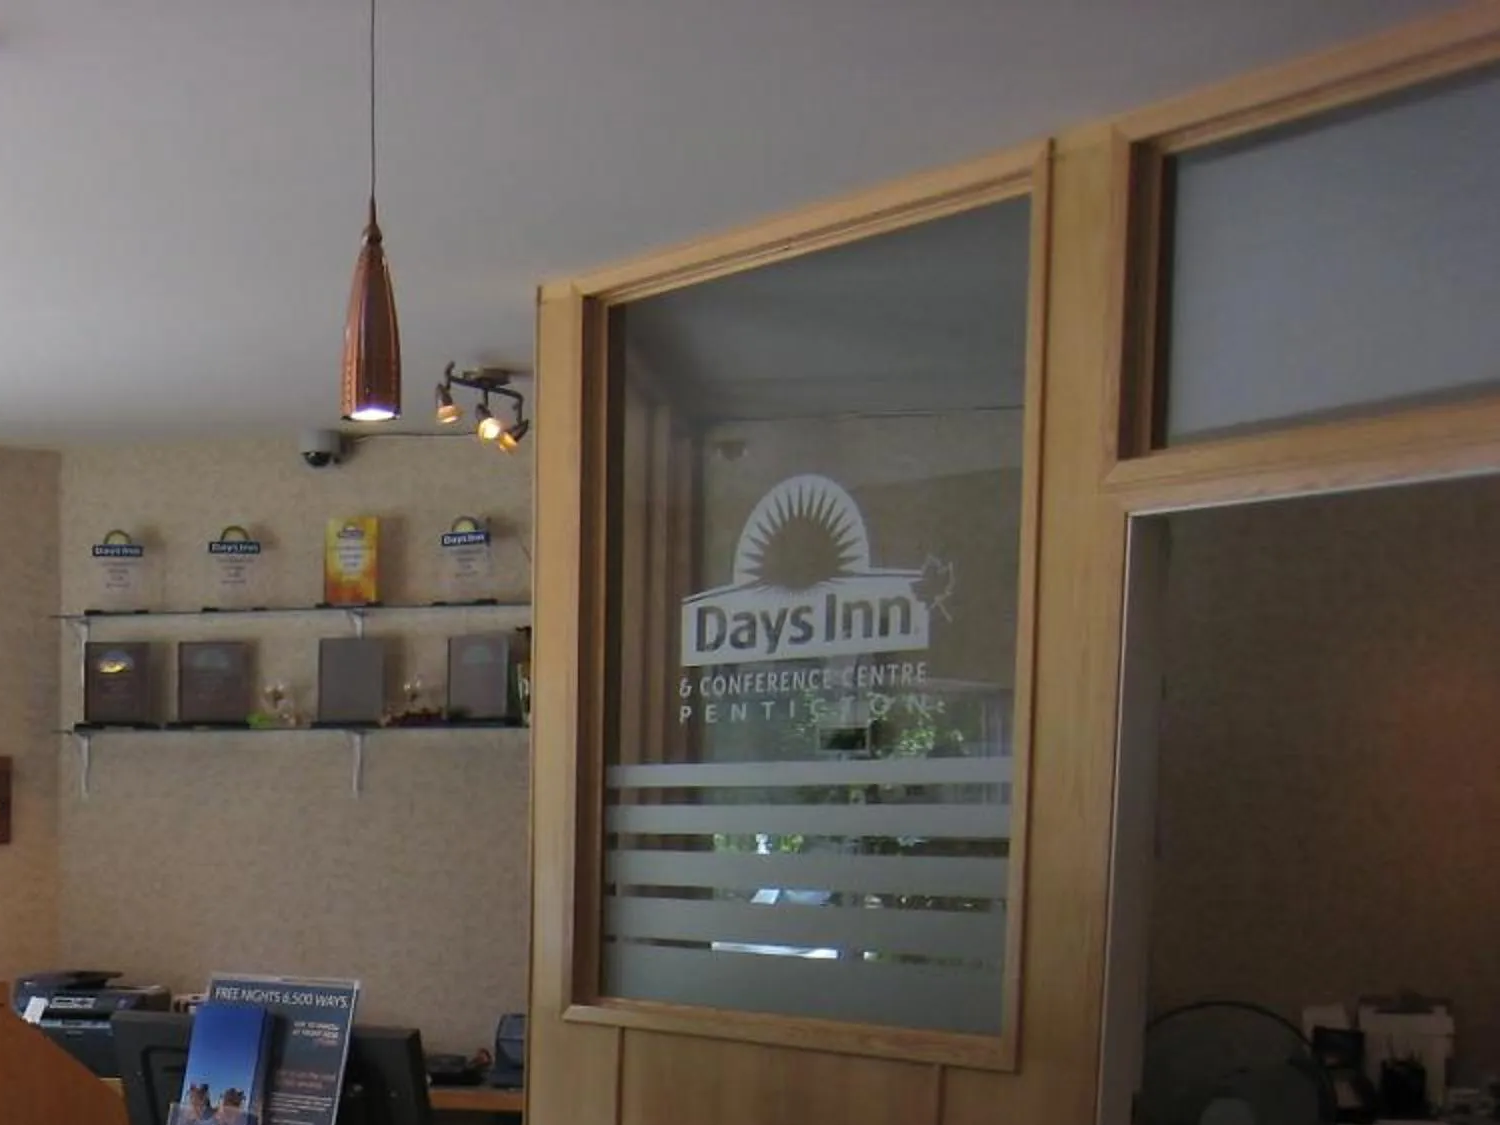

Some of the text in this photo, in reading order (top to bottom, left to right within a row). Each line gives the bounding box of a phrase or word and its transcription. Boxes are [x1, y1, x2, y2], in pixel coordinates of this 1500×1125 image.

[695, 593, 912, 654] Days Inn
[679, 661, 928, 698] & CONFERENCE CENTRE
[215, 987, 237, 1001] FREE
[239, 989, 281, 1003] NIGHTS
